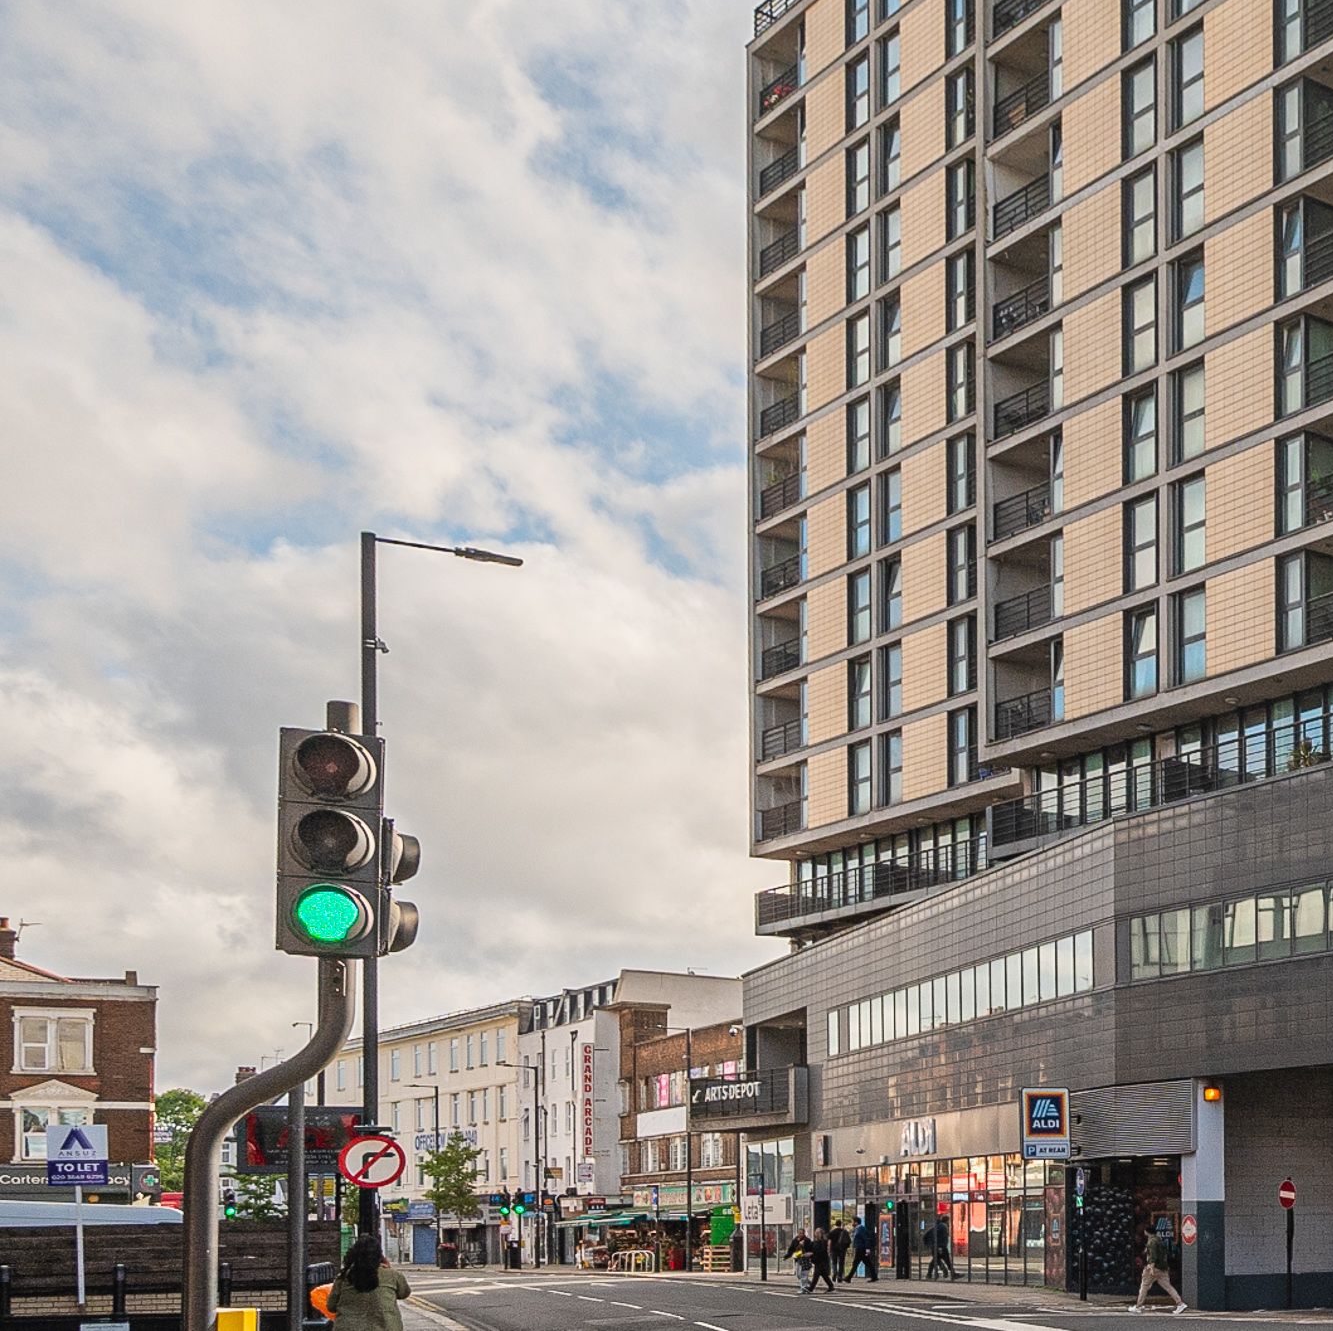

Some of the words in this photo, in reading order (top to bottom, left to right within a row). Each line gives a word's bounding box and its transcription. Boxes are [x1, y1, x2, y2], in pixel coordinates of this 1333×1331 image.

[583, 1044, 592, 1093] GRAND
[584, 1097, 593, 1156] ARCADE
[1032, 1119, 1060, 1128] ALDI
[900, 1118, 937, 1157] ALDI
[1028, 1146, 1035, 1155] P
[55, 1163, 75, 1173] TO
[77, 1163, 100, 1172] LET
